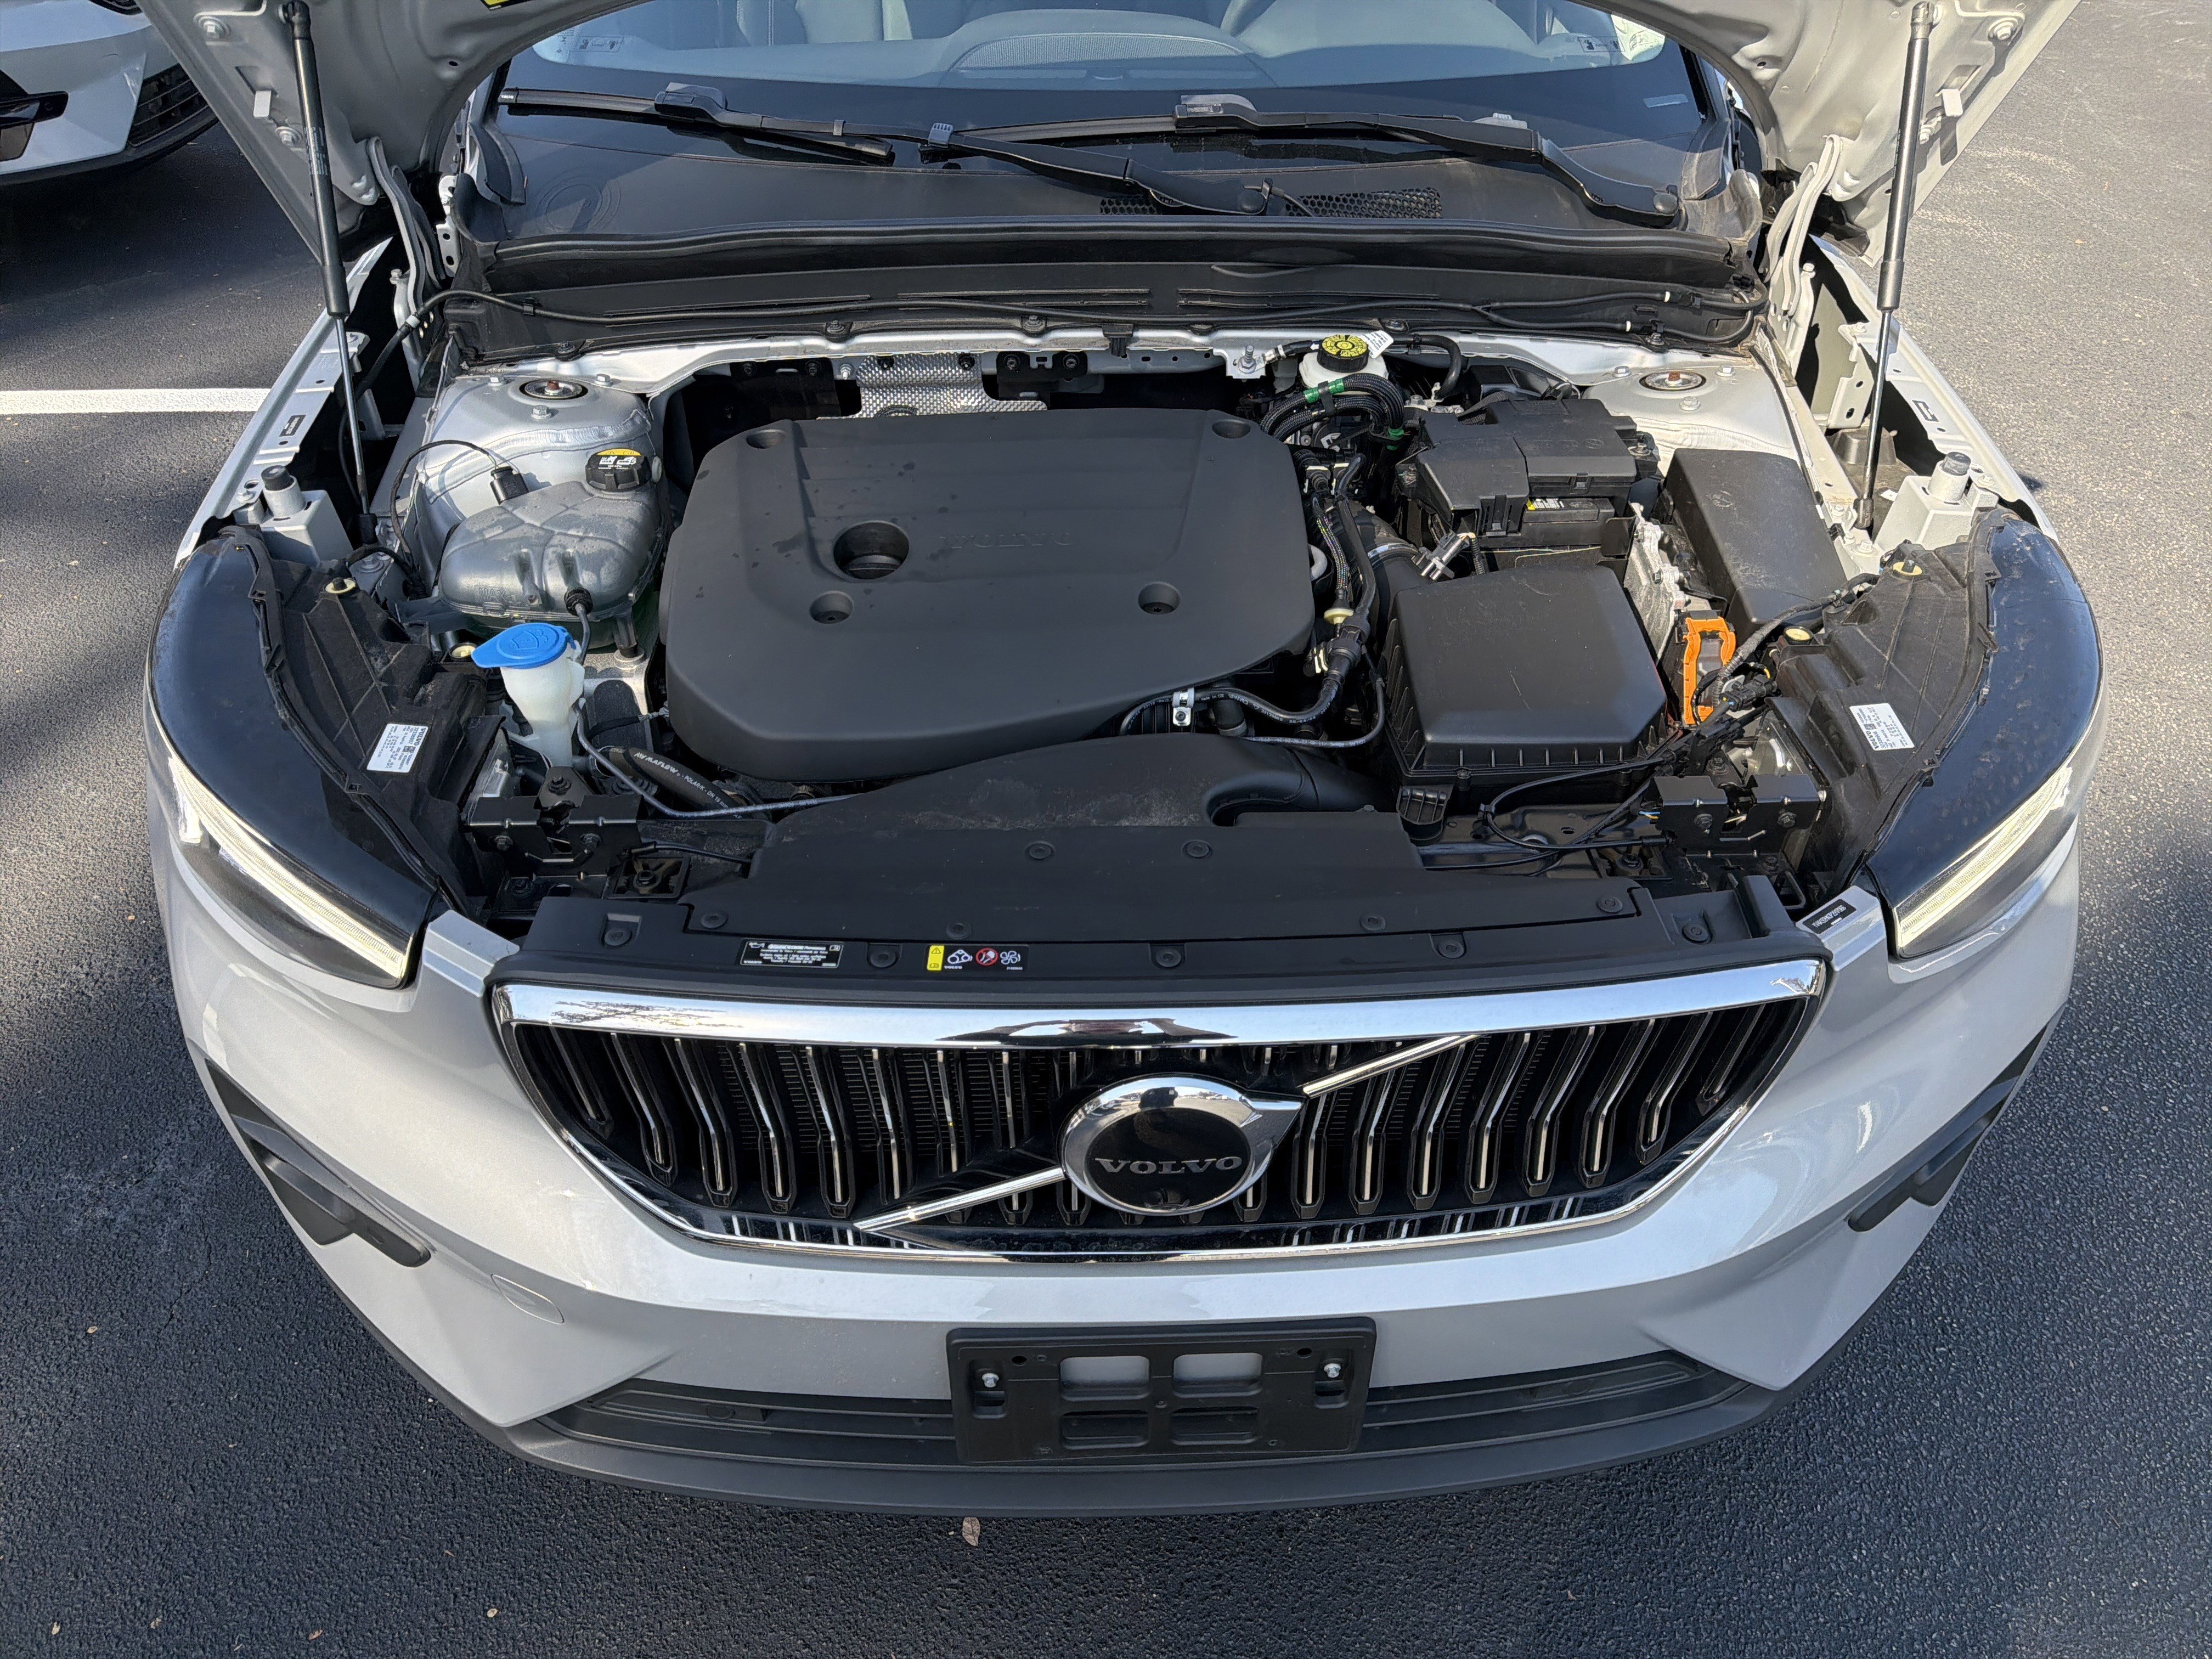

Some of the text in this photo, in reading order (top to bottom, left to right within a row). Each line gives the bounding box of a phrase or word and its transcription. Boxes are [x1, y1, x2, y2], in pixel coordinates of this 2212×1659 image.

[414, 727, 426, 746] VOLVO
[1866, 731, 1880, 749] VOLVO
[1094, 1156, 1243, 1175] VOLVO
